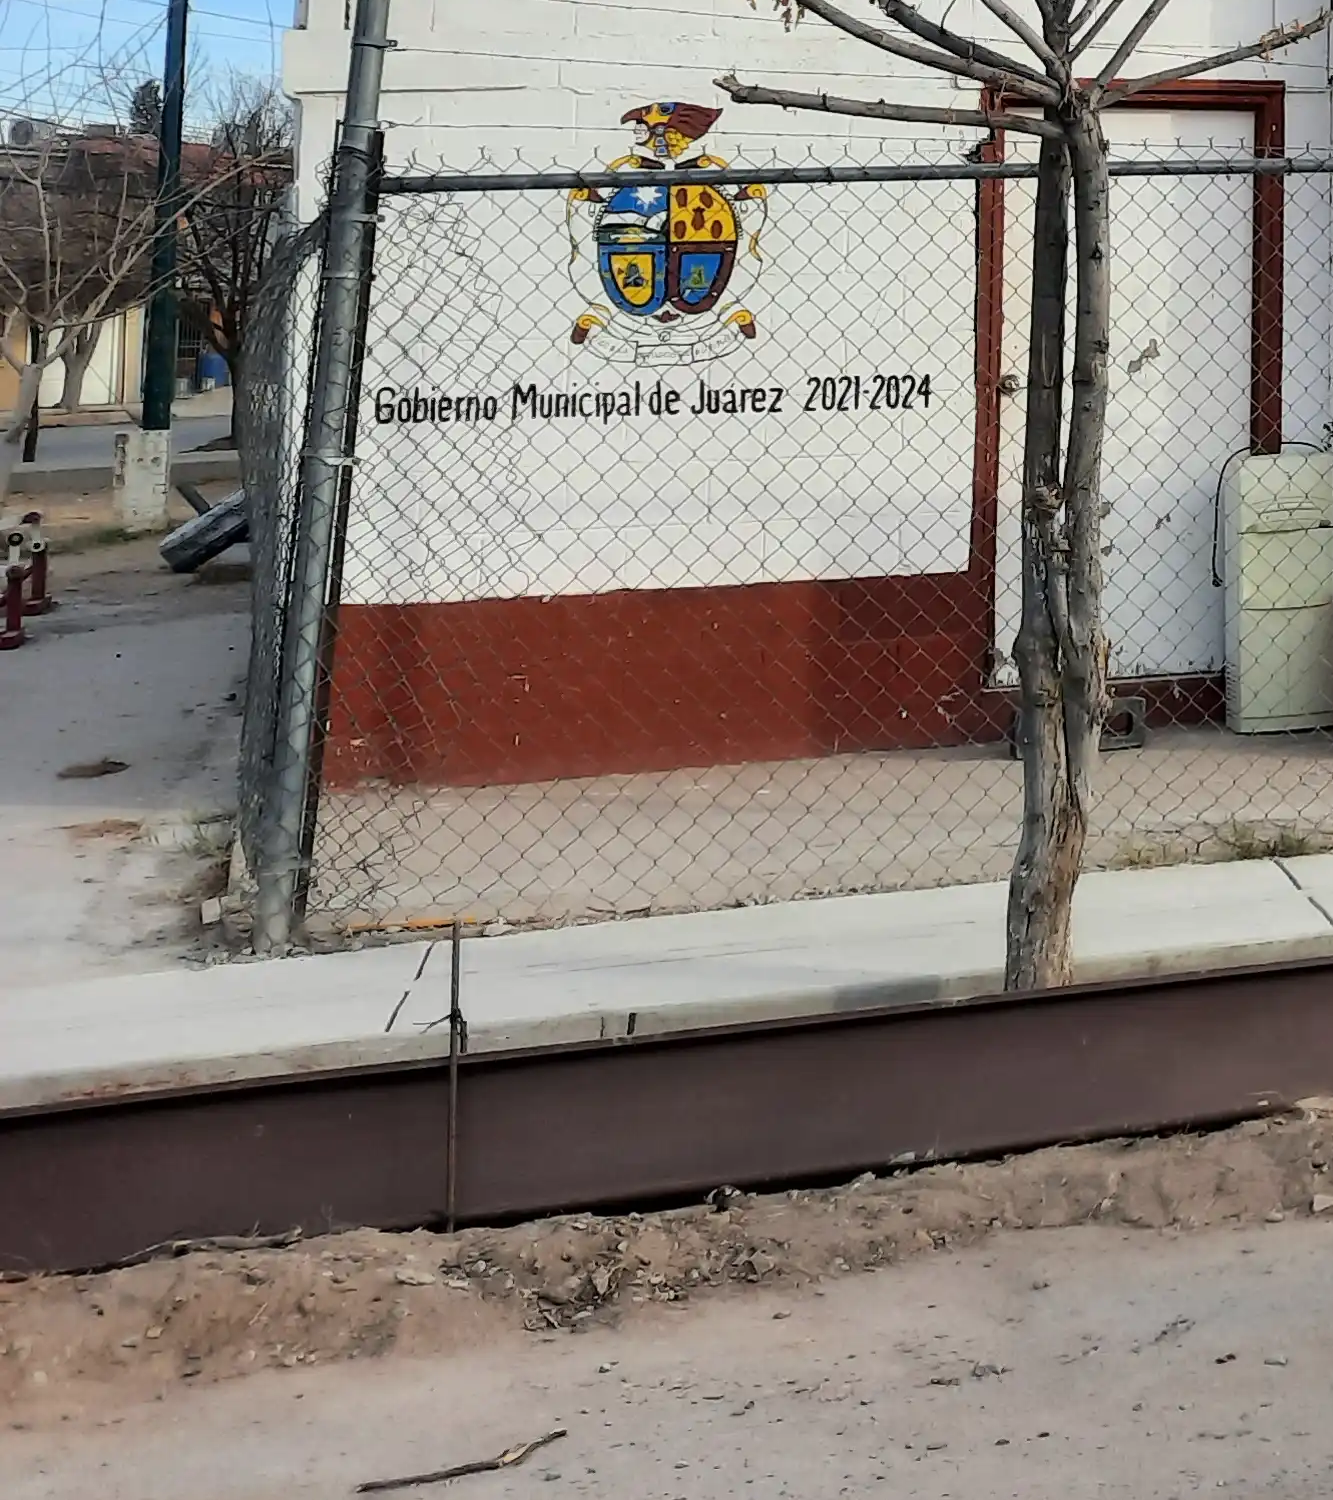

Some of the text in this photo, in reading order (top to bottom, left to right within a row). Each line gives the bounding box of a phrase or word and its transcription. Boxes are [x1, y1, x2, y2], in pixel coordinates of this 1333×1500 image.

[374, 373, 932, 425] Gobierno Municipal de Juárez 2021-2024
